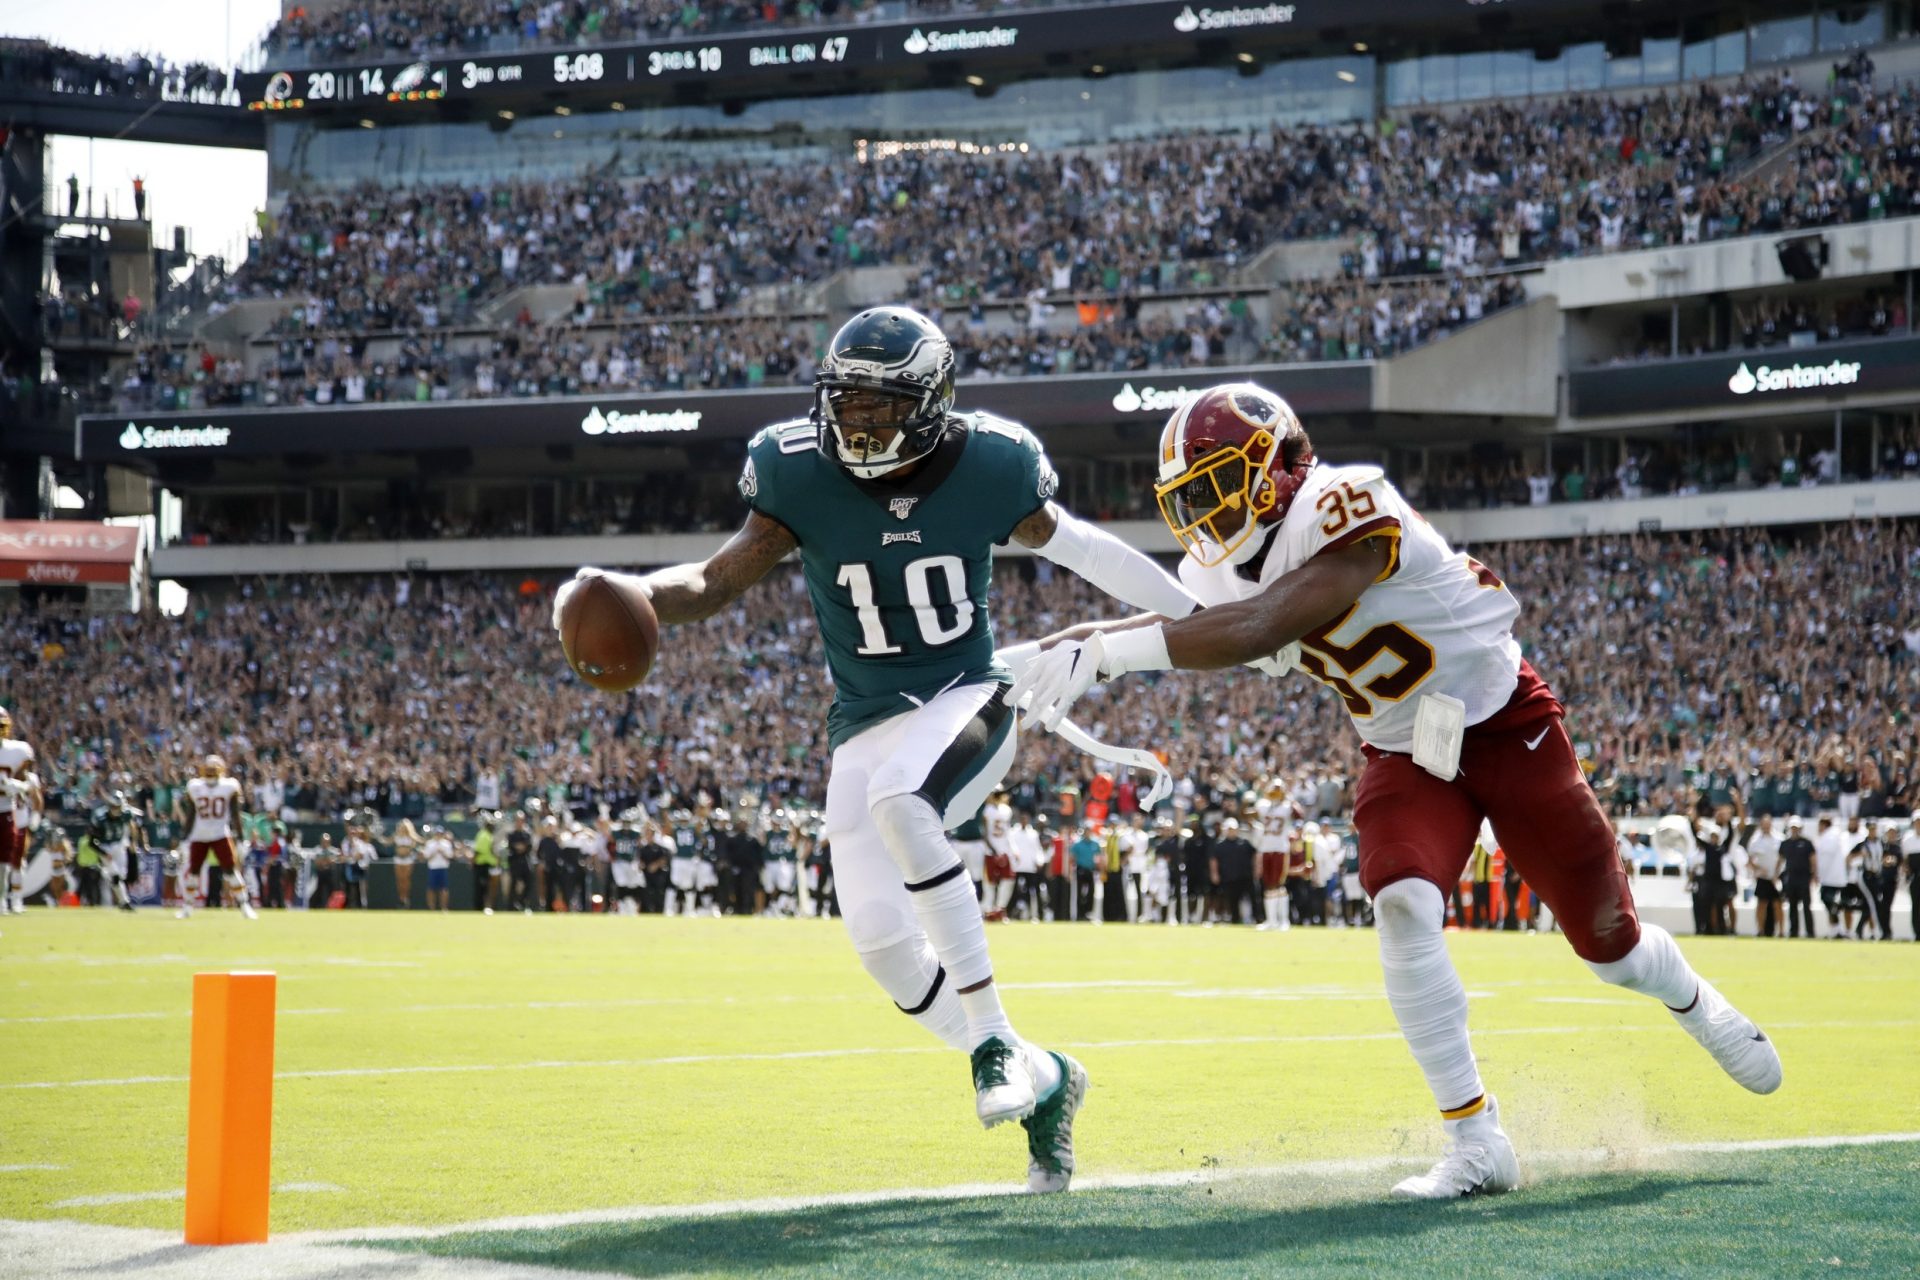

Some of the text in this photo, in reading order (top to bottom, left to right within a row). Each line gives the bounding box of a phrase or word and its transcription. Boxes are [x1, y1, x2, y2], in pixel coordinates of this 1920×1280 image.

[1199, 3, 1295, 30] Santander
[820, 36, 849, 62] 47
[927, 26, 1018, 52] Santander
[554, 52, 604, 83] 5:08
[698, 46, 722, 72] 10
[307, 67, 386, 99] 20 14
[1756, 359, 1861, 392] Santander
[606, 408, 702, 434] Santander
[142, 424, 231, 449] Santander
[1315, 481, 1377, 537] 35
[881, 530, 922, 546] EAGLES
[836, 555, 975, 655] 10
[198, 797, 226, 818] 20
